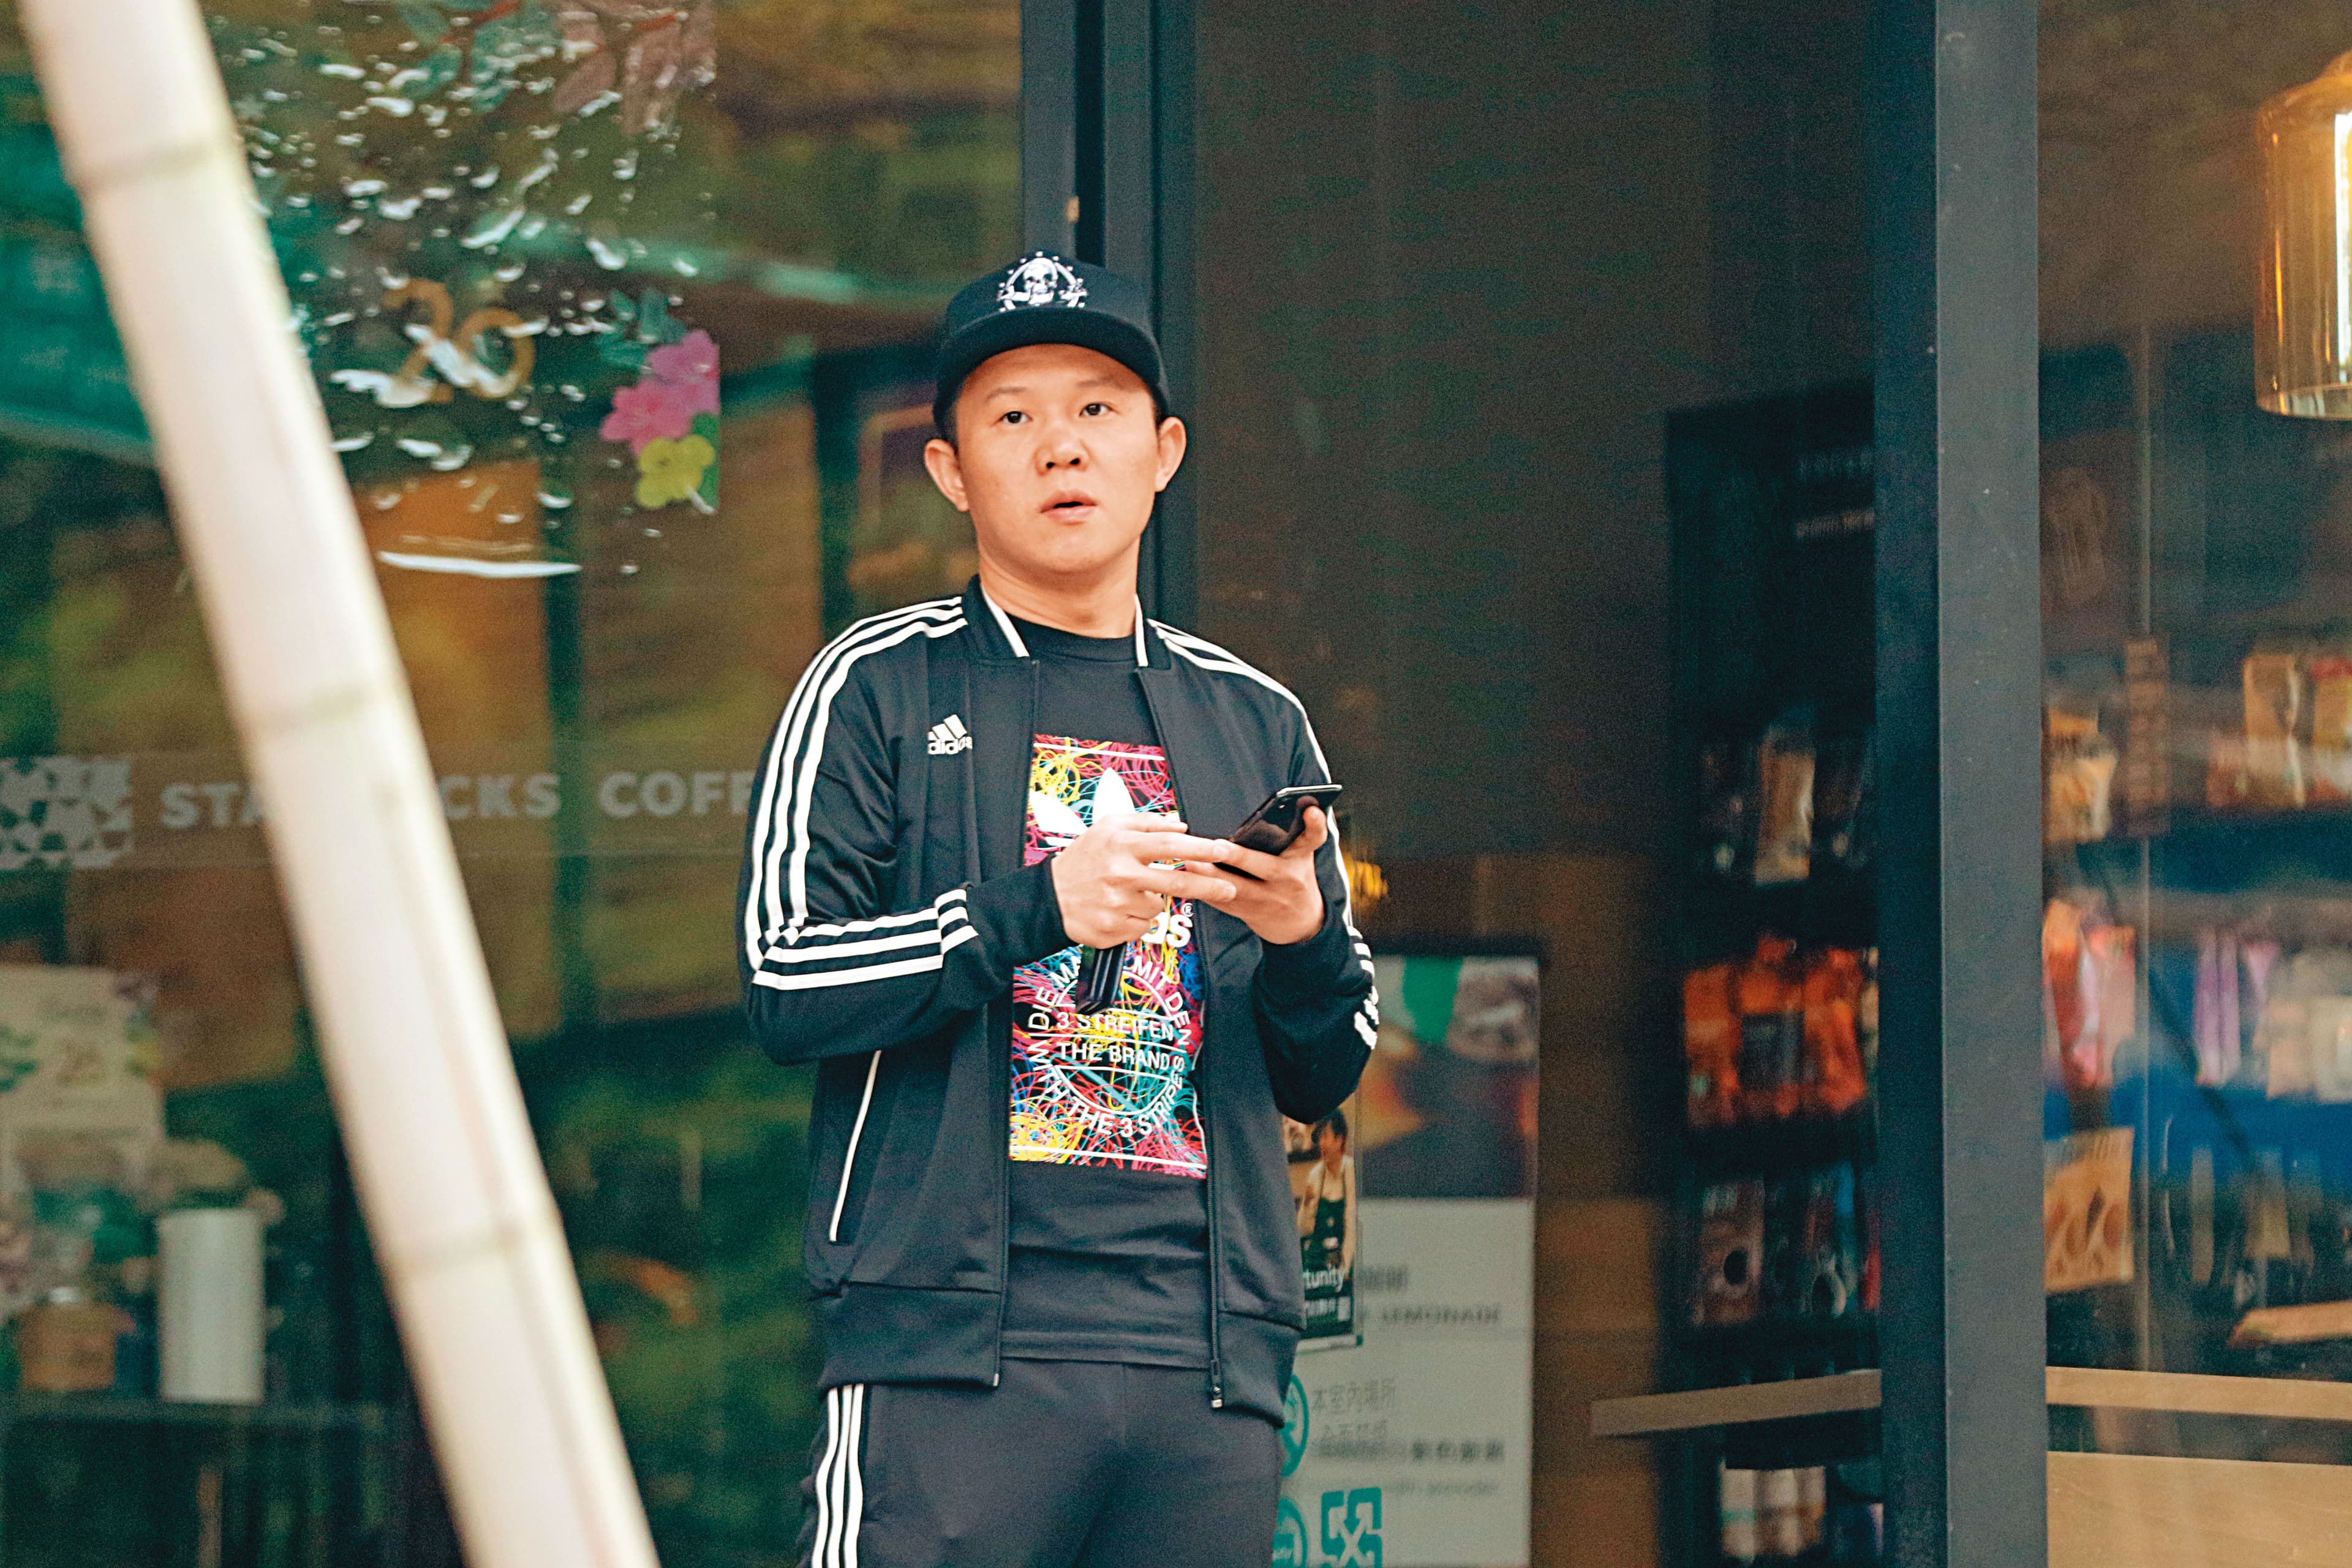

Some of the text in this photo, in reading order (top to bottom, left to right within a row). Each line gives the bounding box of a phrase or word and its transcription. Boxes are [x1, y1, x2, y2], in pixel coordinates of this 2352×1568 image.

[927, 736, 973, 755] didas
[160, 770, 755, 828] STACKS COFF
[1028, 987, 1059, 1030] DIE
[1132, 956, 1172, 990] MIT
[1165, 992, 1192, 1046] DEN
[1057, 1012, 1174, 1041] 3 STREIFEN
[1057, 1042, 1170, 1071] THE BRAND
[1028, 1040, 1185, 1137] WITH THE 3 STRIPES
[1302, 1268, 1344, 1292] tunity
